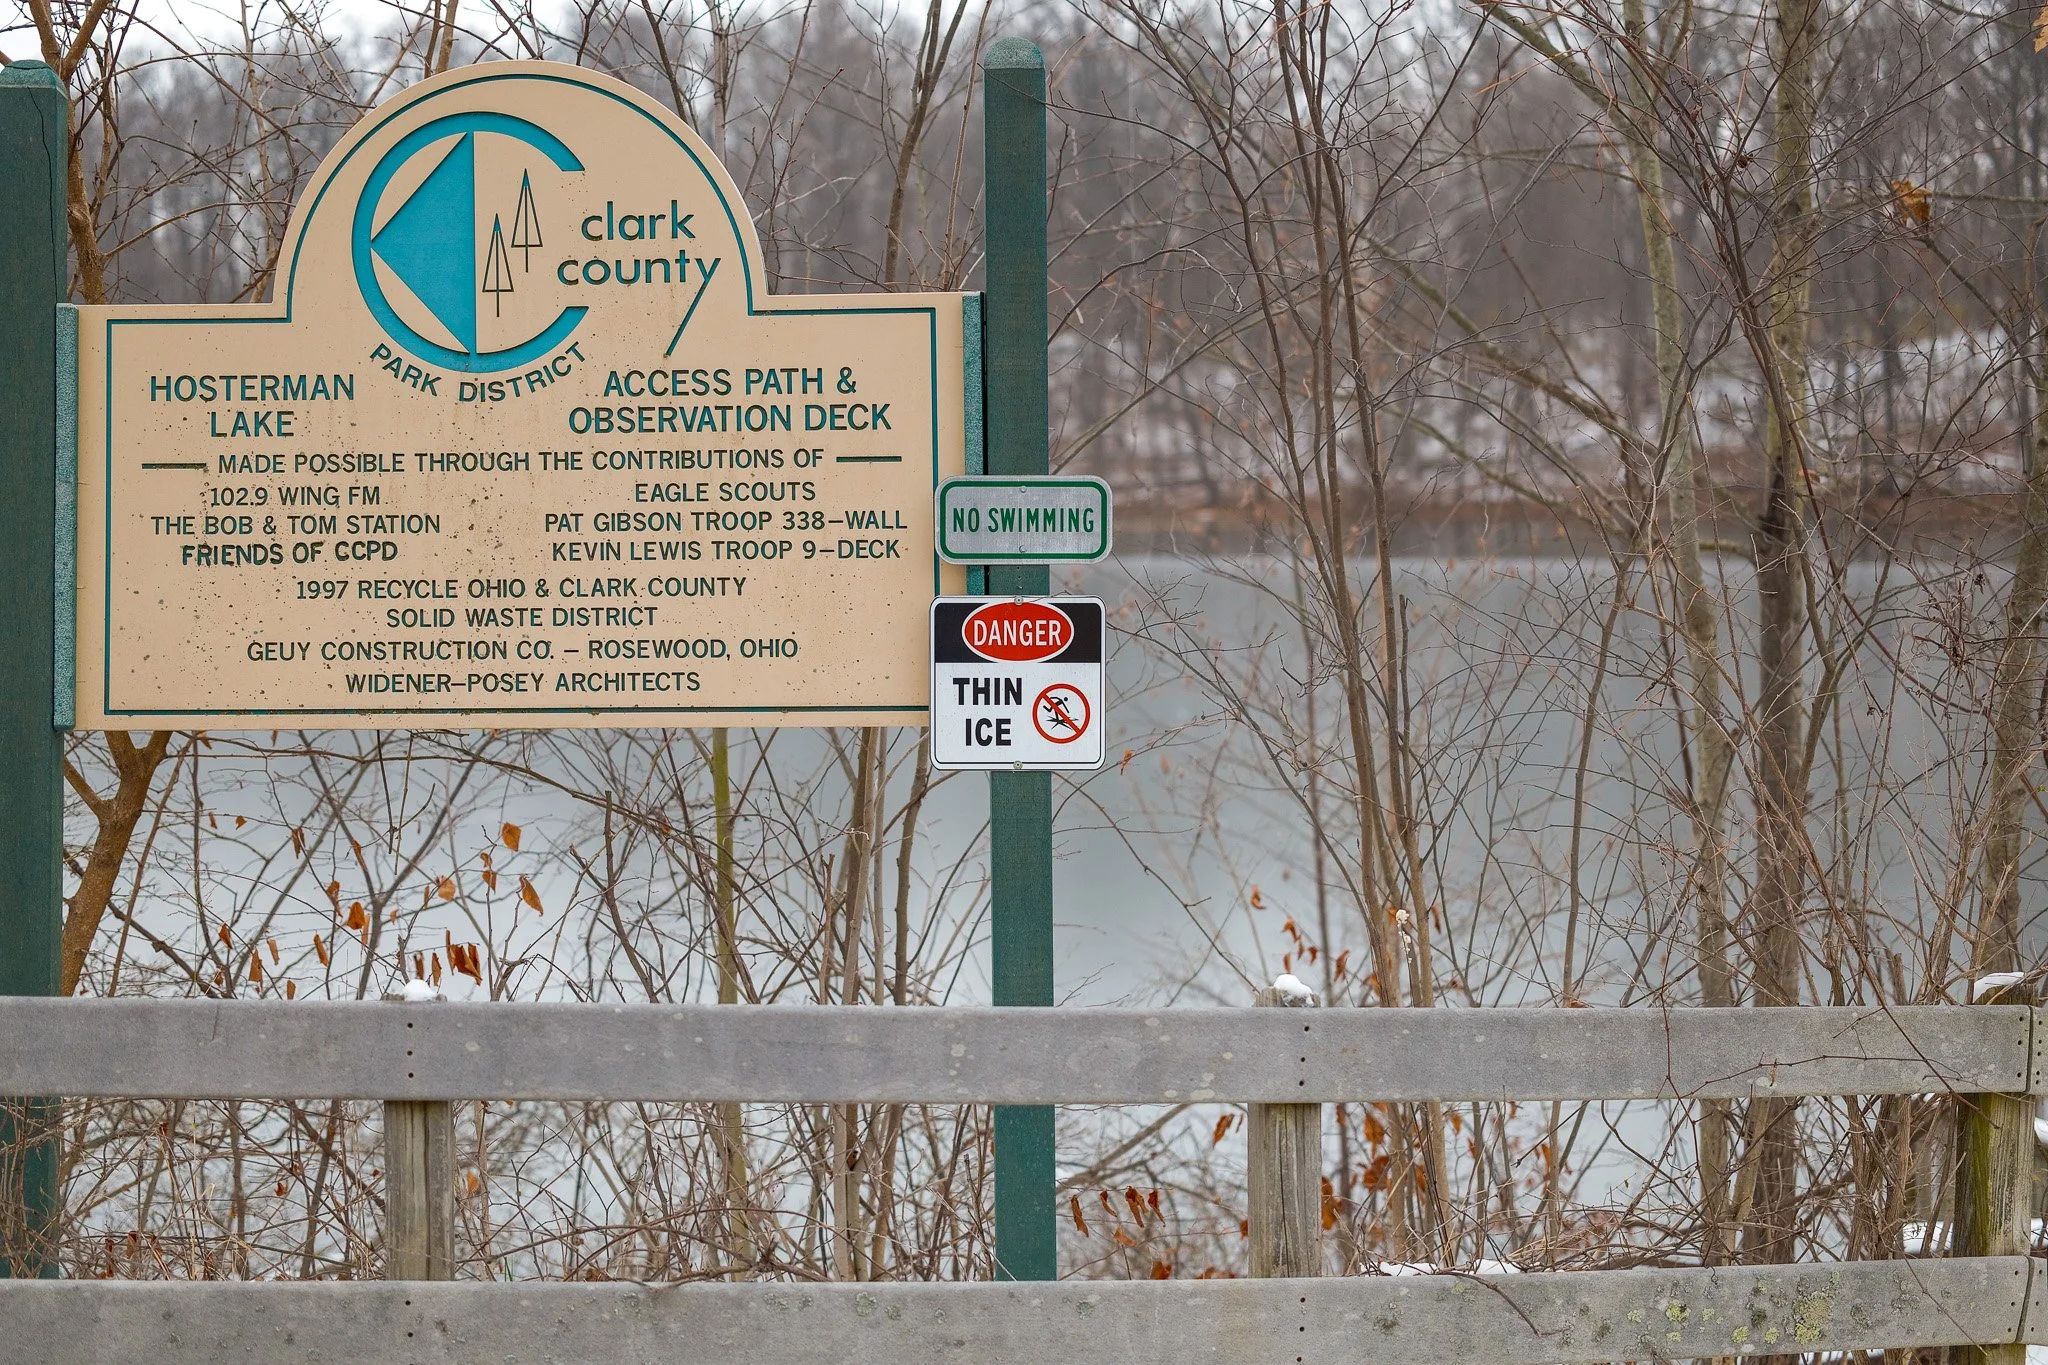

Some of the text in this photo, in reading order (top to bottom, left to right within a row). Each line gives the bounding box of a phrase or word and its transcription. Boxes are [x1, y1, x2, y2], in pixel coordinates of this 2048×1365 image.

[580, 199, 696, 242] clark
[557, 249, 721, 358] county
[368, 341, 588, 403] PARK DISTRICT
[603, 367, 857, 397] ACCESS PATH &
[150, 374, 355, 402] HOSTERMAN
[209, 410, 295, 437] LAKE
[569, 404, 891, 433] OBSERVATION DECK
[218, 448, 824, 474] MADE POSSIBLE THROUGH THE CONTRIBUTIONS OF
[210, 486, 381, 506] 102.9 WING FM
[635, 481, 816, 502] EAGLE SCOUTS
[151, 514, 441, 535] THE BOB & TOM STATION
[545, 513, 585, 532] PAT
[593, 512, 683, 532] GIBSON
[693, 511, 772, 531] TROOP
[953, 508, 1094, 532] NO SWIMMING
[181, 541, 398, 566] FRIENDS OF CCPD
[552, 542, 621, 561] KEVIN
[631, 541, 702, 561] LEWIS
[712, 540, 792, 560] TROOP
[296, 576, 747, 600] 1997 RECYCLE OHIO & CLARK COUNTY
[386, 607, 658, 628] SOLID WASTE DISTRICT
[973, 620, 1061, 646] DANGER
[246, 642, 311, 662] GEUY
[321, 640, 508, 661] CONSTRUCTION
[516, 640, 554, 659] CO.
[588, 638, 732, 661] ROSEWOOD,
[740, 638, 798, 658] OHIO
[555, 672, 700, 692] ARCHITECTS
[953, 677, 1022, 706] THIN
[965, 718, 1012, 746] ICE
